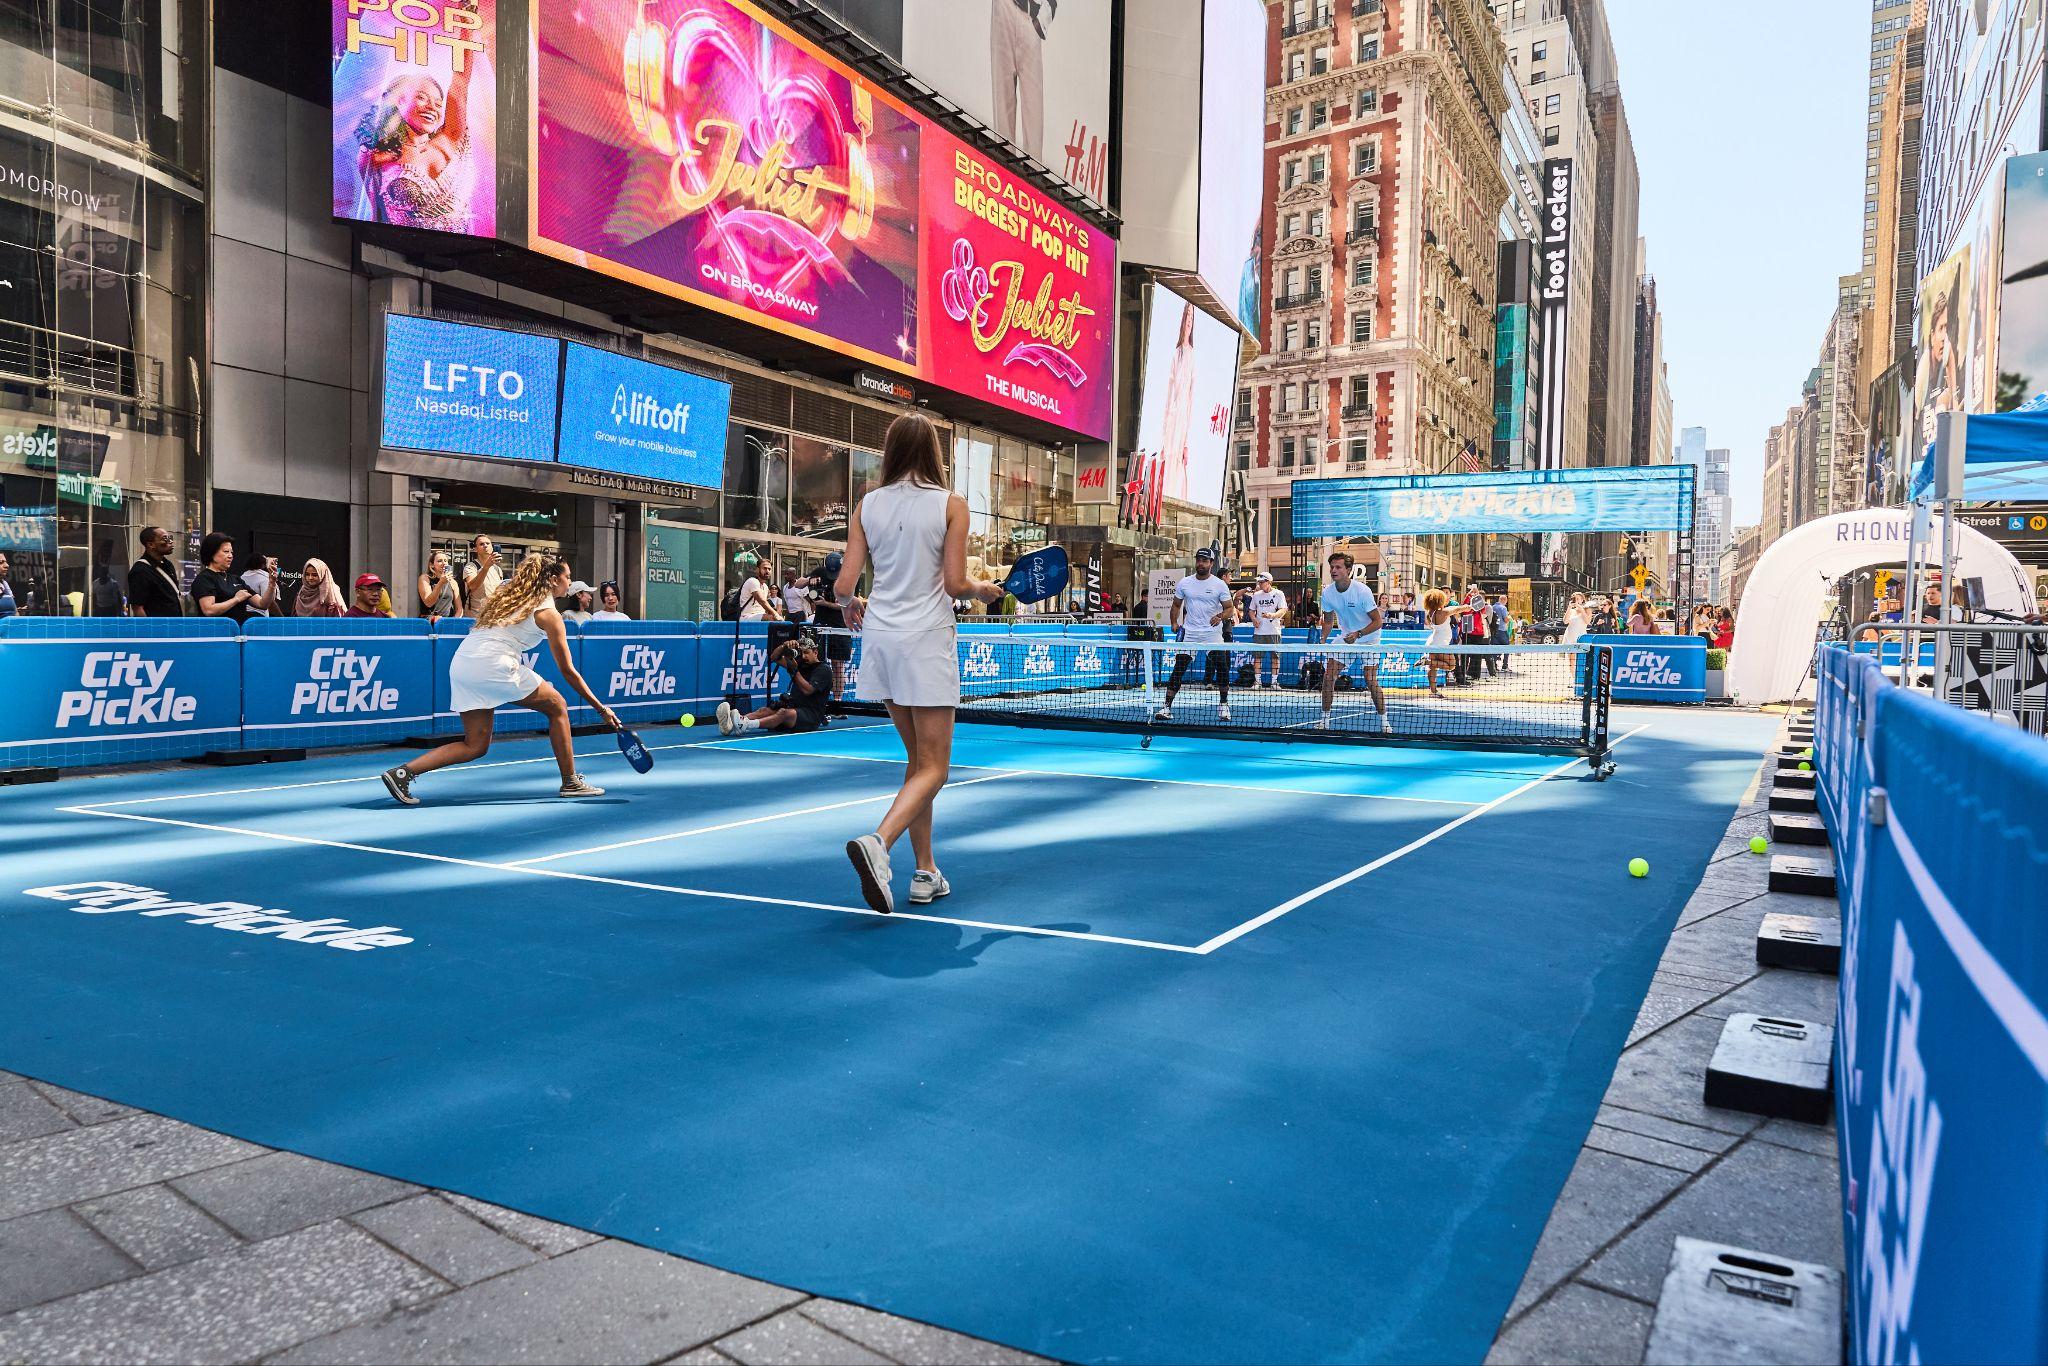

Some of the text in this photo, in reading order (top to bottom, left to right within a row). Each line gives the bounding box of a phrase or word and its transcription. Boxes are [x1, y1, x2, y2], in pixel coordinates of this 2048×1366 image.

[346, 18, 485, 73] HIT
[670, 119, 850, 223] Juliet
[1063, 119, 1107, 204] H&M
[955, 149, 1089, 249] BROADWAY'S
[954, 176, 1089, 278] BIGGEST POP HIT
[701, 264, 819, 316] ON BROADWAY
[1543, 249, 1566, 299] Foot
[971, 260, 1095, 353] Juliet
[423, 360, 524, 400] LFTO
[986, 373, 1062, 415] THE MUSICAL
[629, 391, 690, 435] liftoff
[1209, 403, 1229, 438] H&M
[595, 430, 698, 458] Grow your mobile business
[573, 471, 698, 500] NASDAQ MARKETSITE
[1079, 467, 1107, 488] H&M
[1837, 522, 1911, 541] RHONE
[1961, 517, 2043, 527] Street N
[649, 549, 665, 557] TIMES
[651, 535, 660, 547] 4
[648, 568, 686, 584] RETAIL
[649, 556, 671, 564] SQUARE
[1157, 579, 1176, 588] Hype
[80, 652, 174, 695] City
[309, 648, 381, 690] City
[621, 644, 665, 675] City
[1615, 667, 1682, 684] Pickle
[1626, 650, 1670, 670] City
[290, 680, 400, 715] Pickle
[608, 669, 677, 697] Pickle
[55, 687, 198, 728] Pickle
